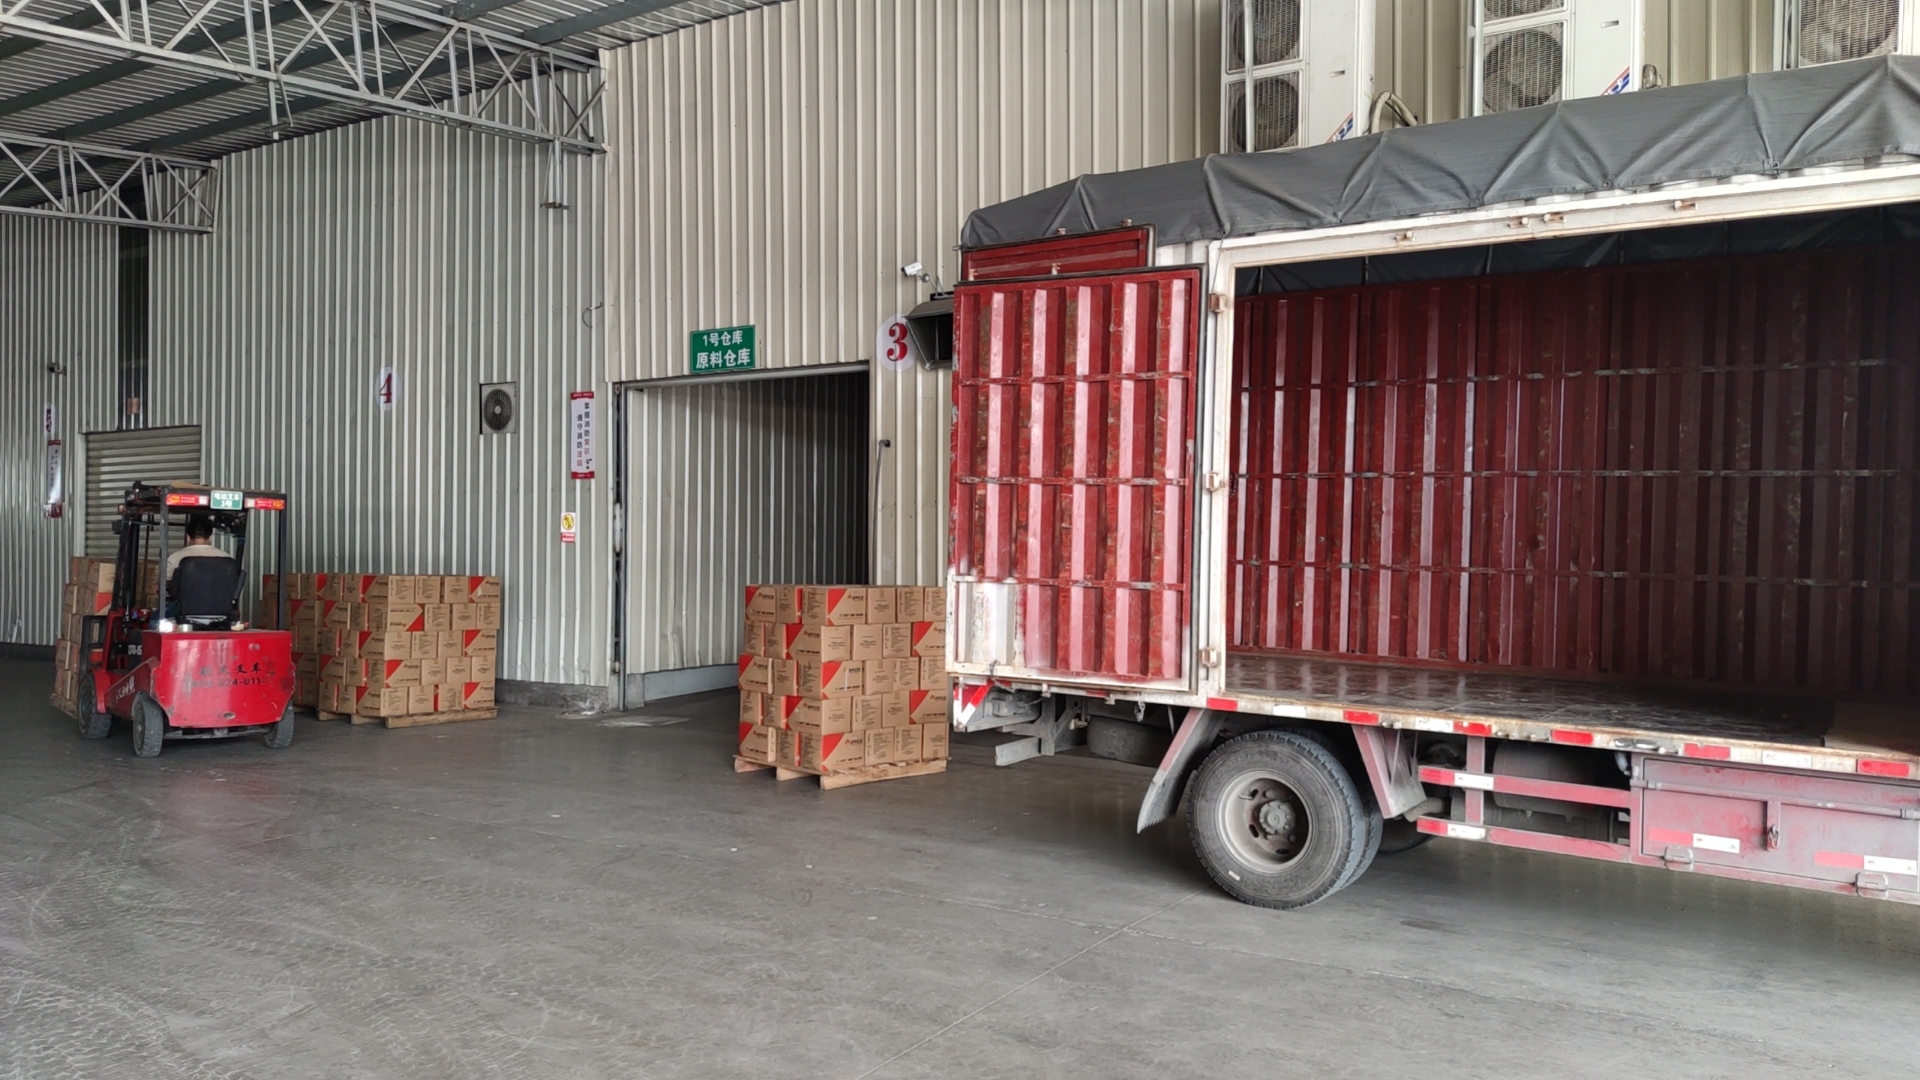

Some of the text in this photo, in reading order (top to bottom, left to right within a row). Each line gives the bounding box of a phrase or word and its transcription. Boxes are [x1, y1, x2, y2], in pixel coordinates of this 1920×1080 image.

[703, 330, 743, 347] 1号仓库
[887, 322, 908, 362] 3
[696, 348, 751, 369] 原料仓库
[379, 373, 392, 404] 4
